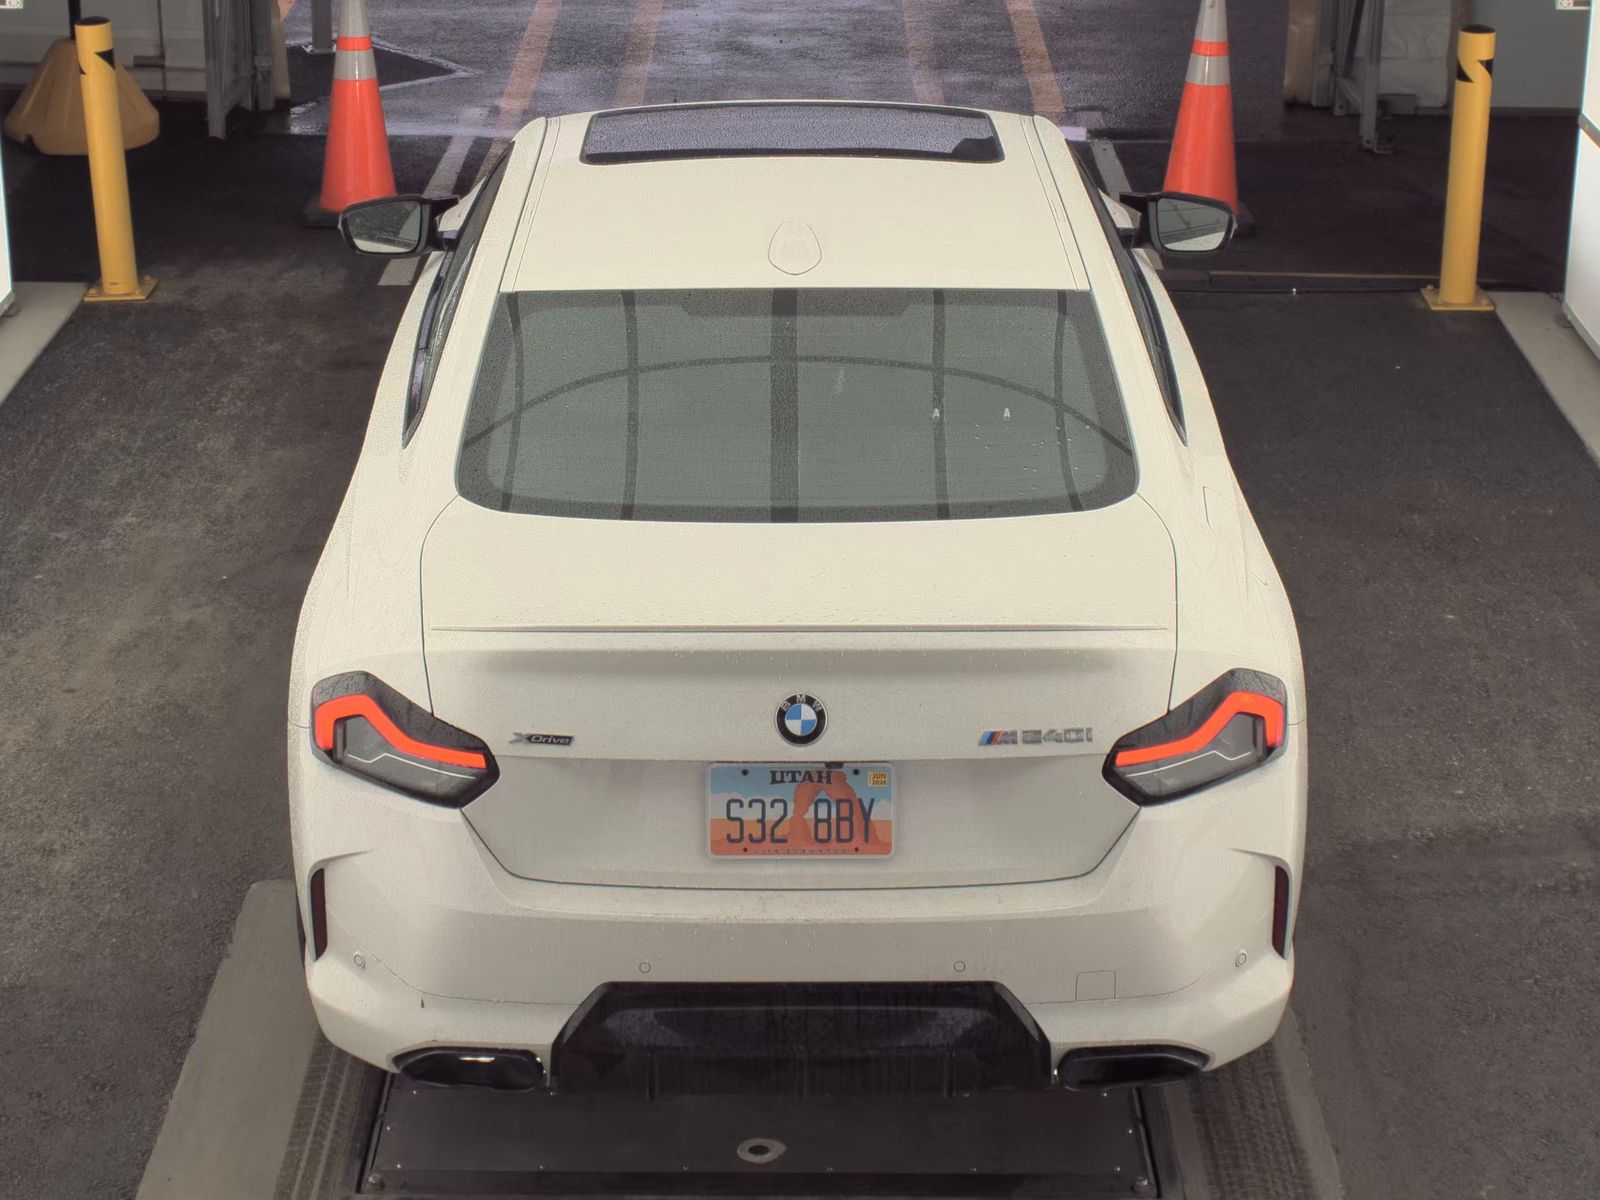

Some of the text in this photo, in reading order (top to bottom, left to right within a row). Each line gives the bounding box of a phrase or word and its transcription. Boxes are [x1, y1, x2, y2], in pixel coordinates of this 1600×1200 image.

[780, 694, 823, 711] BMW
[769, 769, 833, 785] UTAH
[726, 798, 875, 844] S32 8BY
